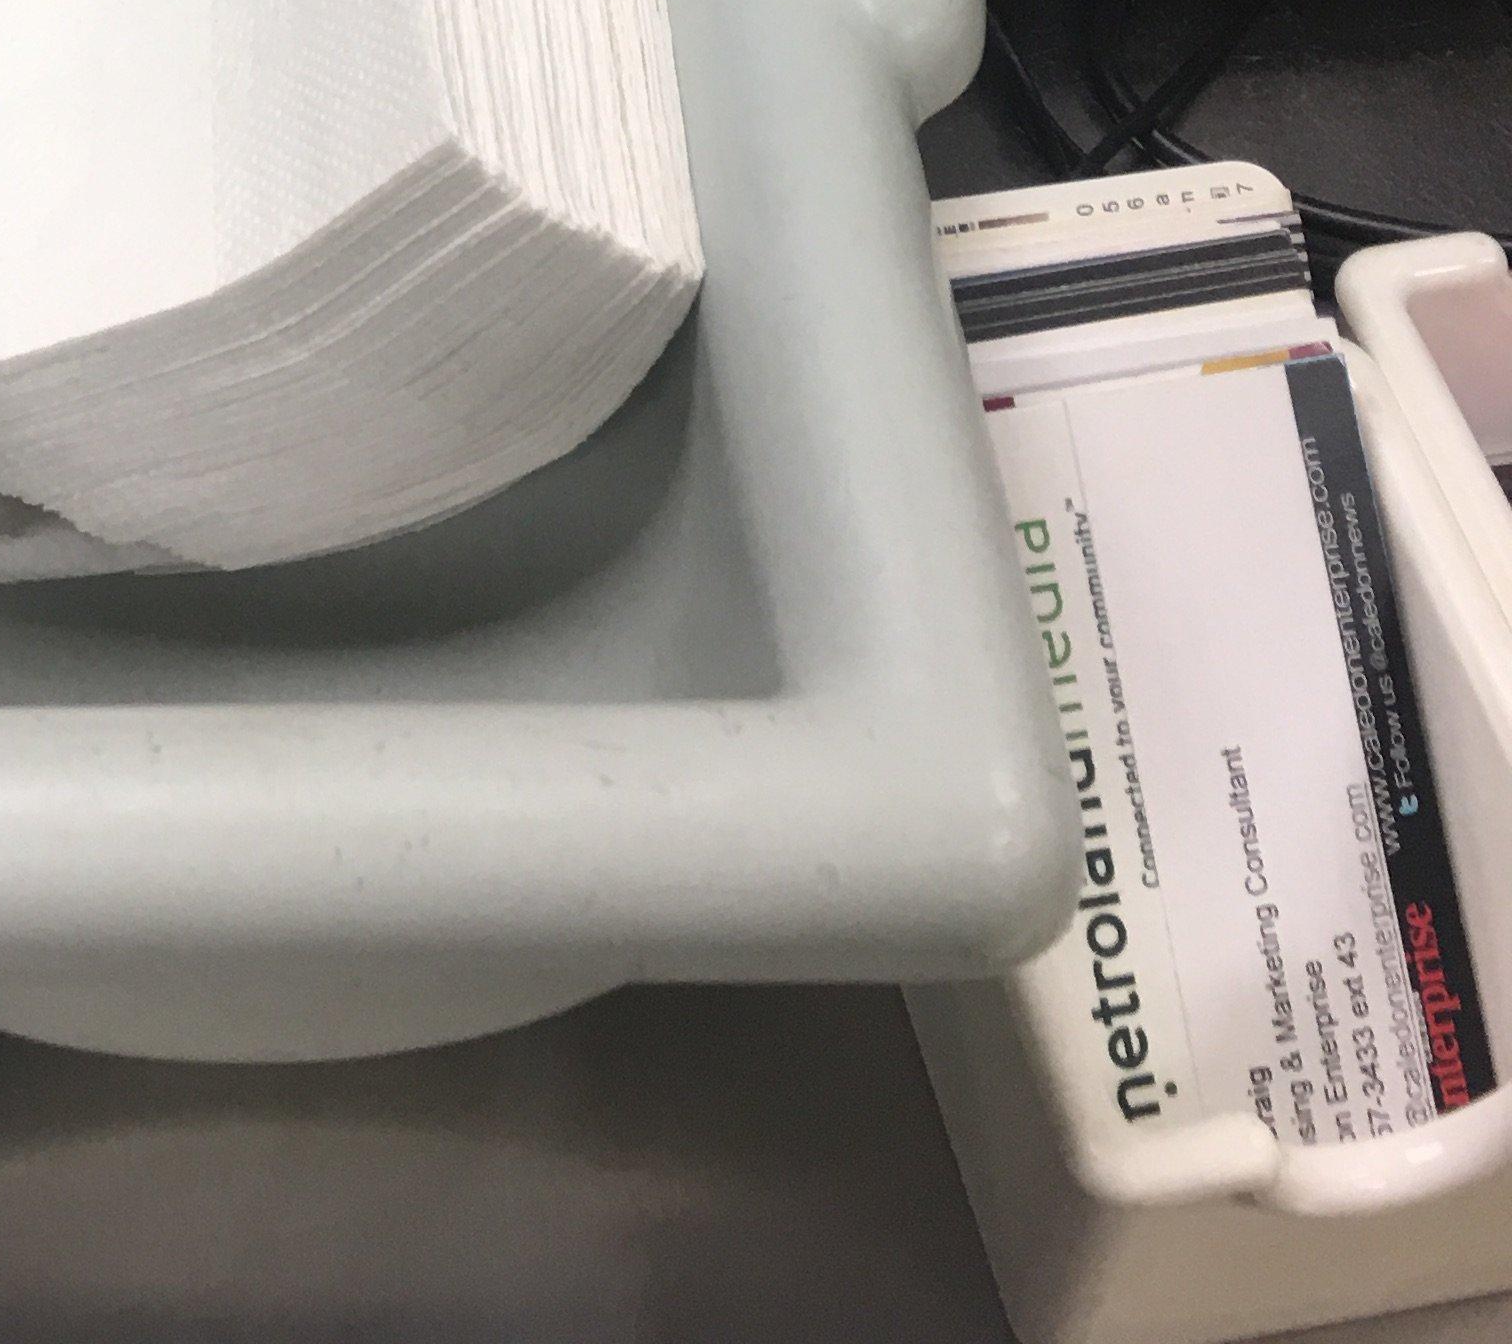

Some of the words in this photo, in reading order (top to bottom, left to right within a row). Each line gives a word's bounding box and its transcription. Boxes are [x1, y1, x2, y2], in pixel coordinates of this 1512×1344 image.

[1303, 435, 1403, 857] www.caledonenterprise.com
[1376, 673, 1399, 705] us
[1109, 716, 1133, 748] to
[1380, 707, 1416, 789] Follow
[1115, 750, 1161, 891] Connected
[1218, 743, 1271, 898] Consultant
[1250, 900, 1303, 1043] Marketing
[1331, 930, 1362, 971] 43
[1298, 956, 1351, 1105] Enterprise
[1341, 971, 1371, 1020] ext
[1397, 901, 1474, 1110] nterprise
[1279, 1048, 1304, 1072] &
[1244, 1062, 1285, 1142] raig
